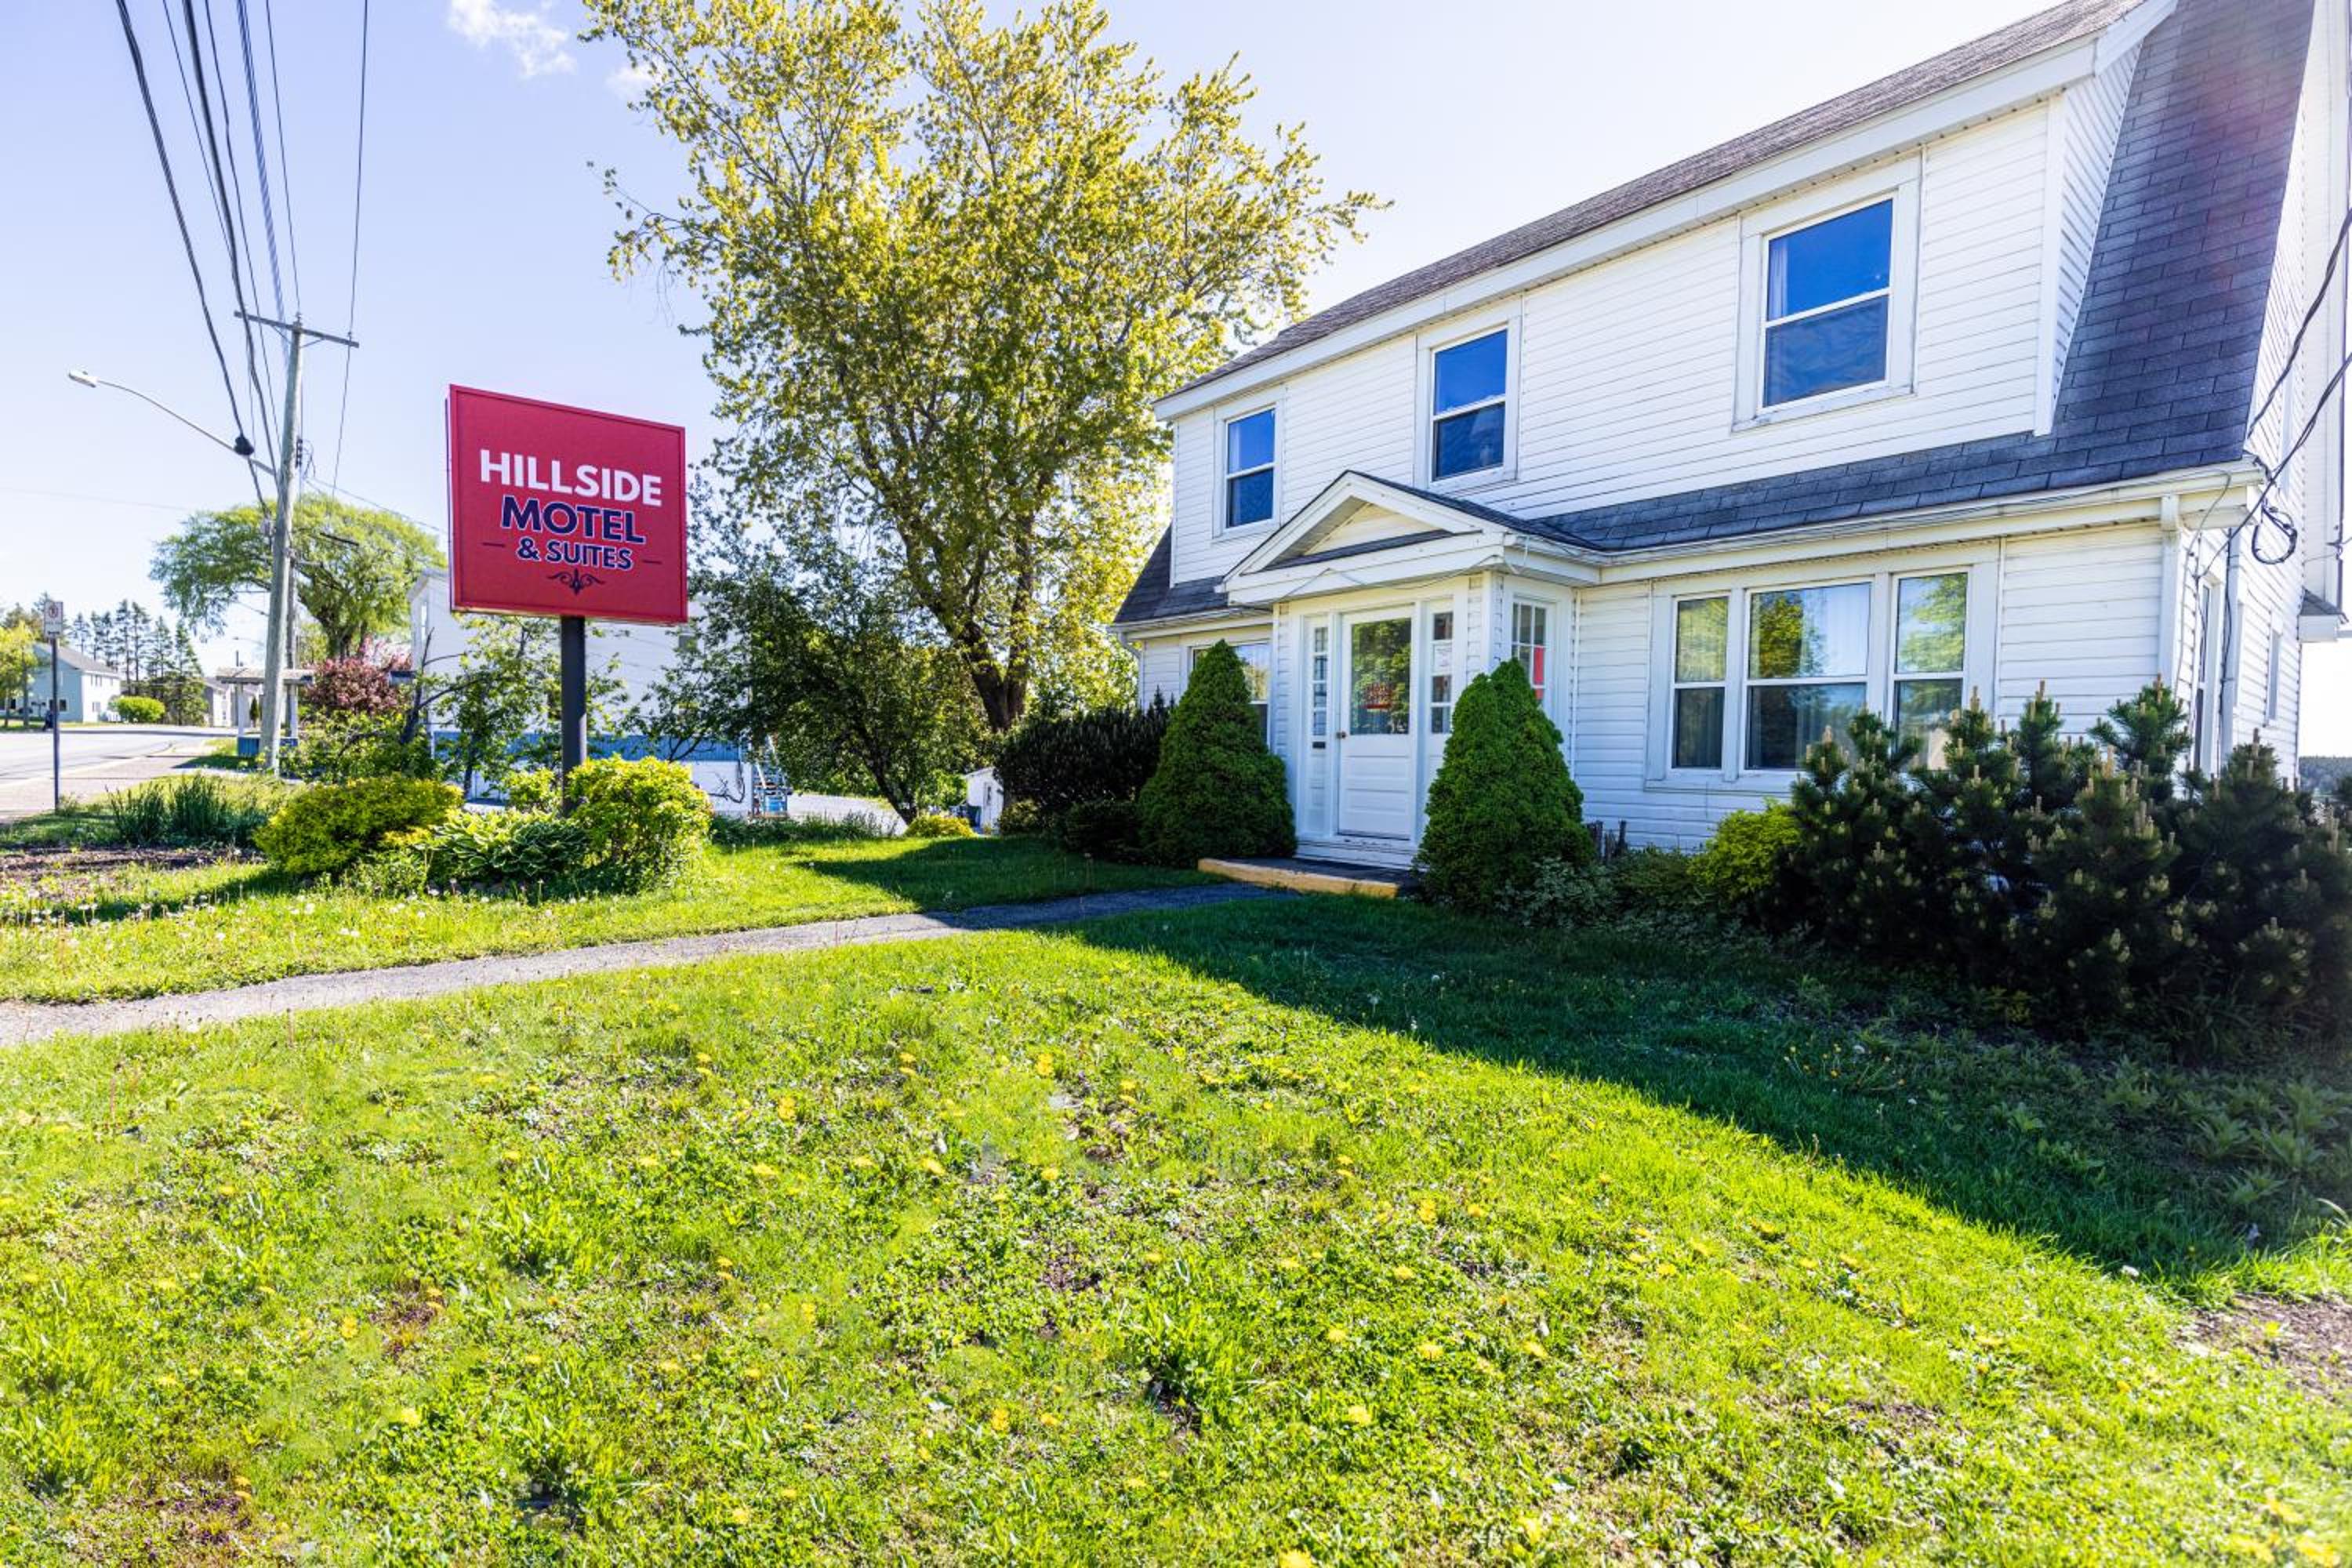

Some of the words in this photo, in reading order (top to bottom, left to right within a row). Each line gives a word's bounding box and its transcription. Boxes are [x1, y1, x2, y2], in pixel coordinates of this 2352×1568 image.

[480, 448, 662, 506] HILLSIDE
[500, 495, 647, 545] MOTEL
[516, 535, 541, 562] &
[545, 539, 634, 571] SUITES
